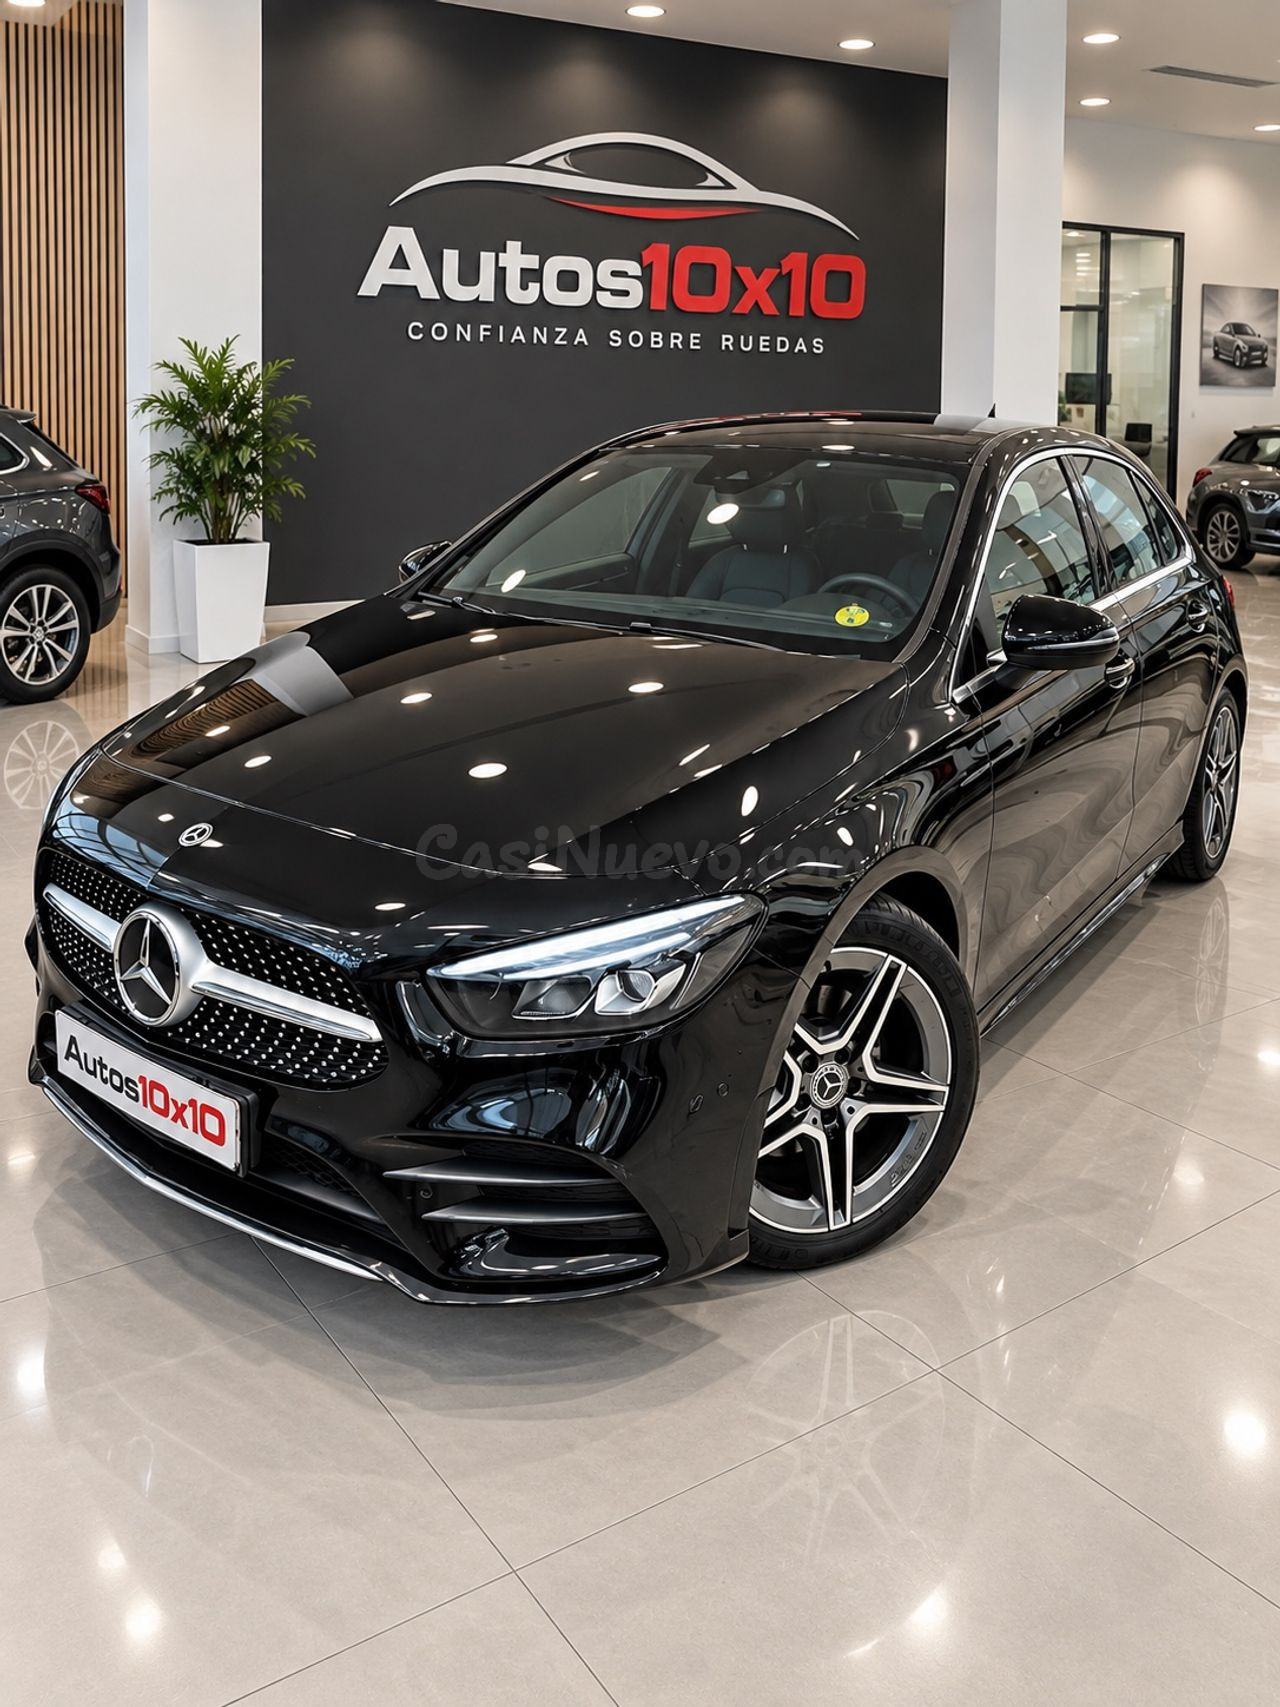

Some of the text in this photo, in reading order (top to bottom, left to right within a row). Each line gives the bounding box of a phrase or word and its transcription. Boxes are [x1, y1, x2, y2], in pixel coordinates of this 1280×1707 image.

[357, 225, 867, 320] Autos10x10
[407, 321, 825, 354] CONFIANZA SOBRE RUEDAS
[63, 1034, 227, 1148] Autos10x10
